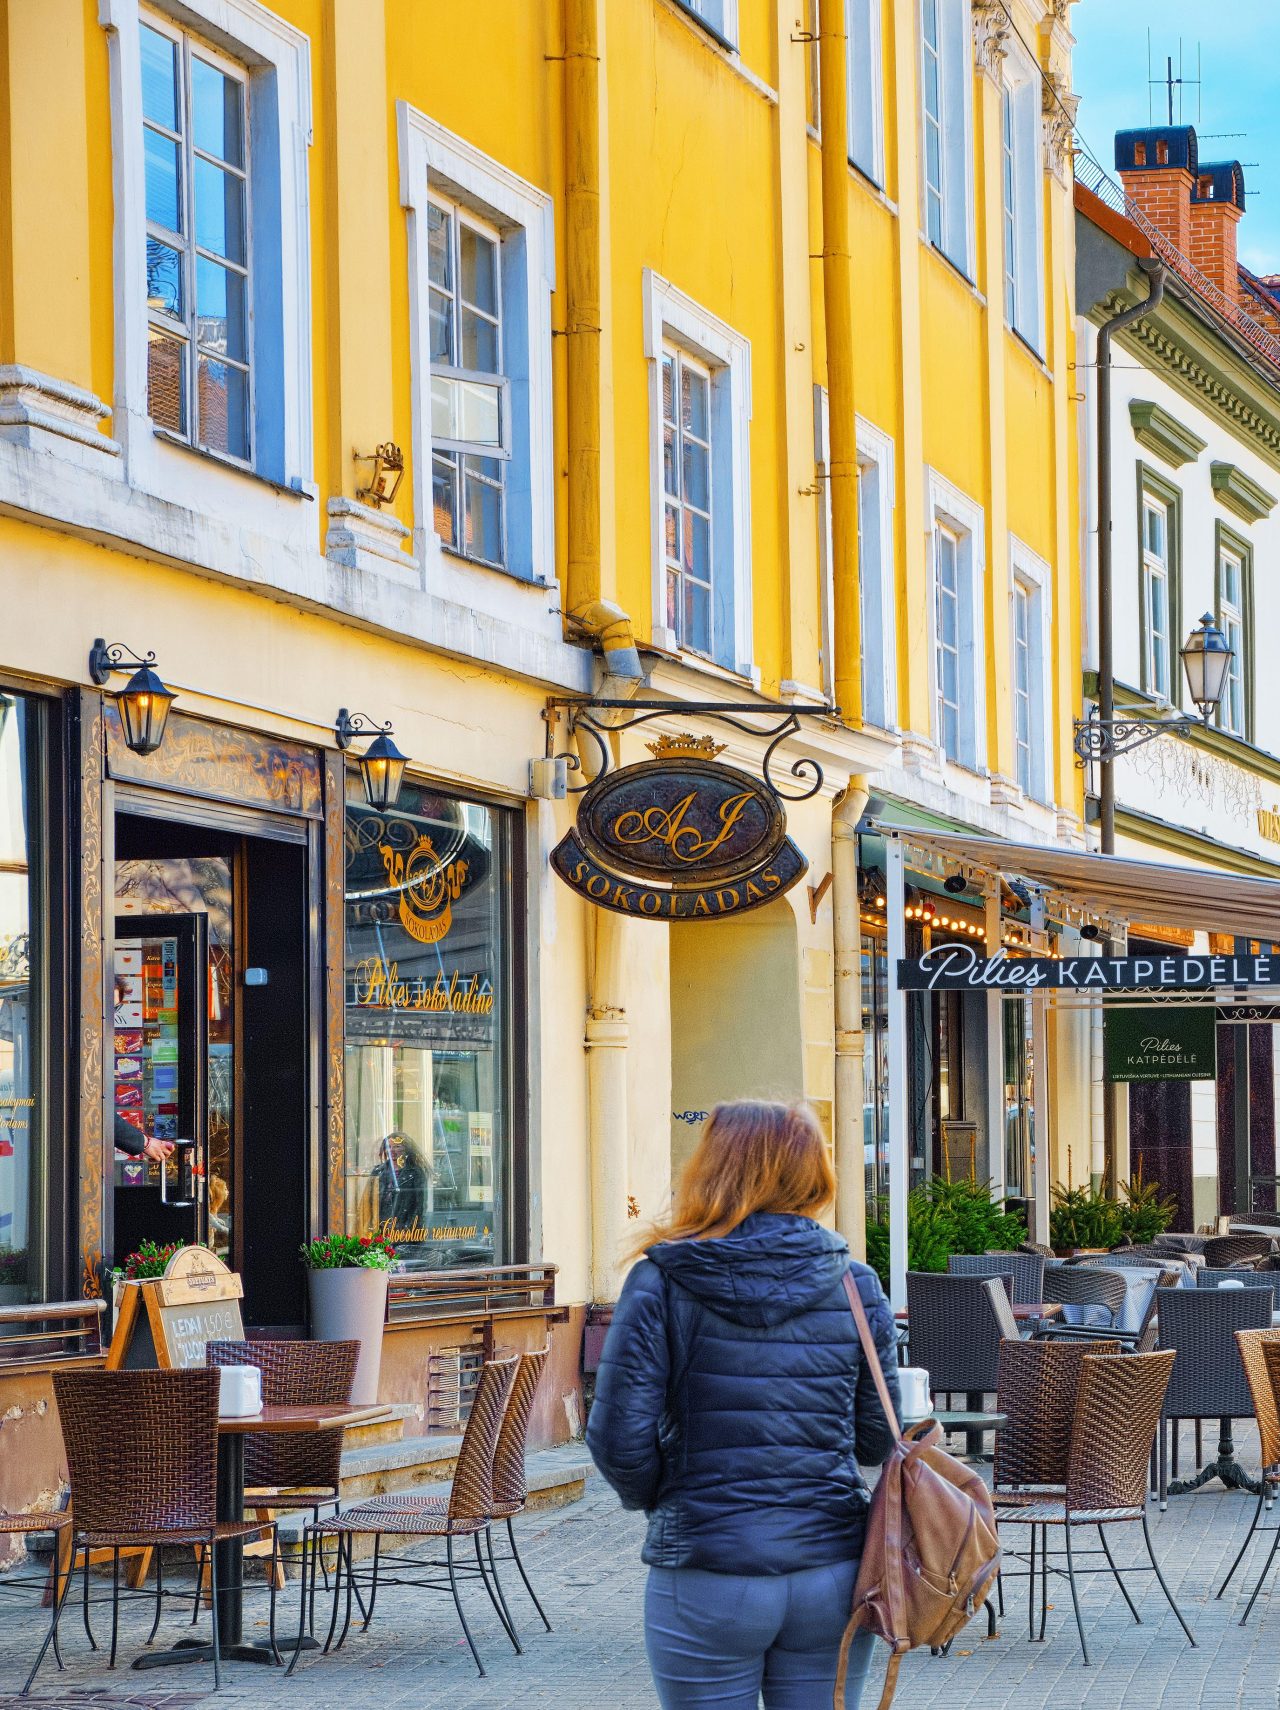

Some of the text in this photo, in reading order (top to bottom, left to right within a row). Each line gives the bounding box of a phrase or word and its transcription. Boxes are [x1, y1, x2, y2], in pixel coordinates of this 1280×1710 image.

[567, 853, 782, 917] ŠOKOLADAS
[918, 943, 1047, 989] Pilies
[1058, 954, 1271, 985] KATPĖDĖLĖ
[1127, 1053, 1197, 1064] KATPĖDĖLĖ
[1140, 1036, 1182, 1053] Pilies
